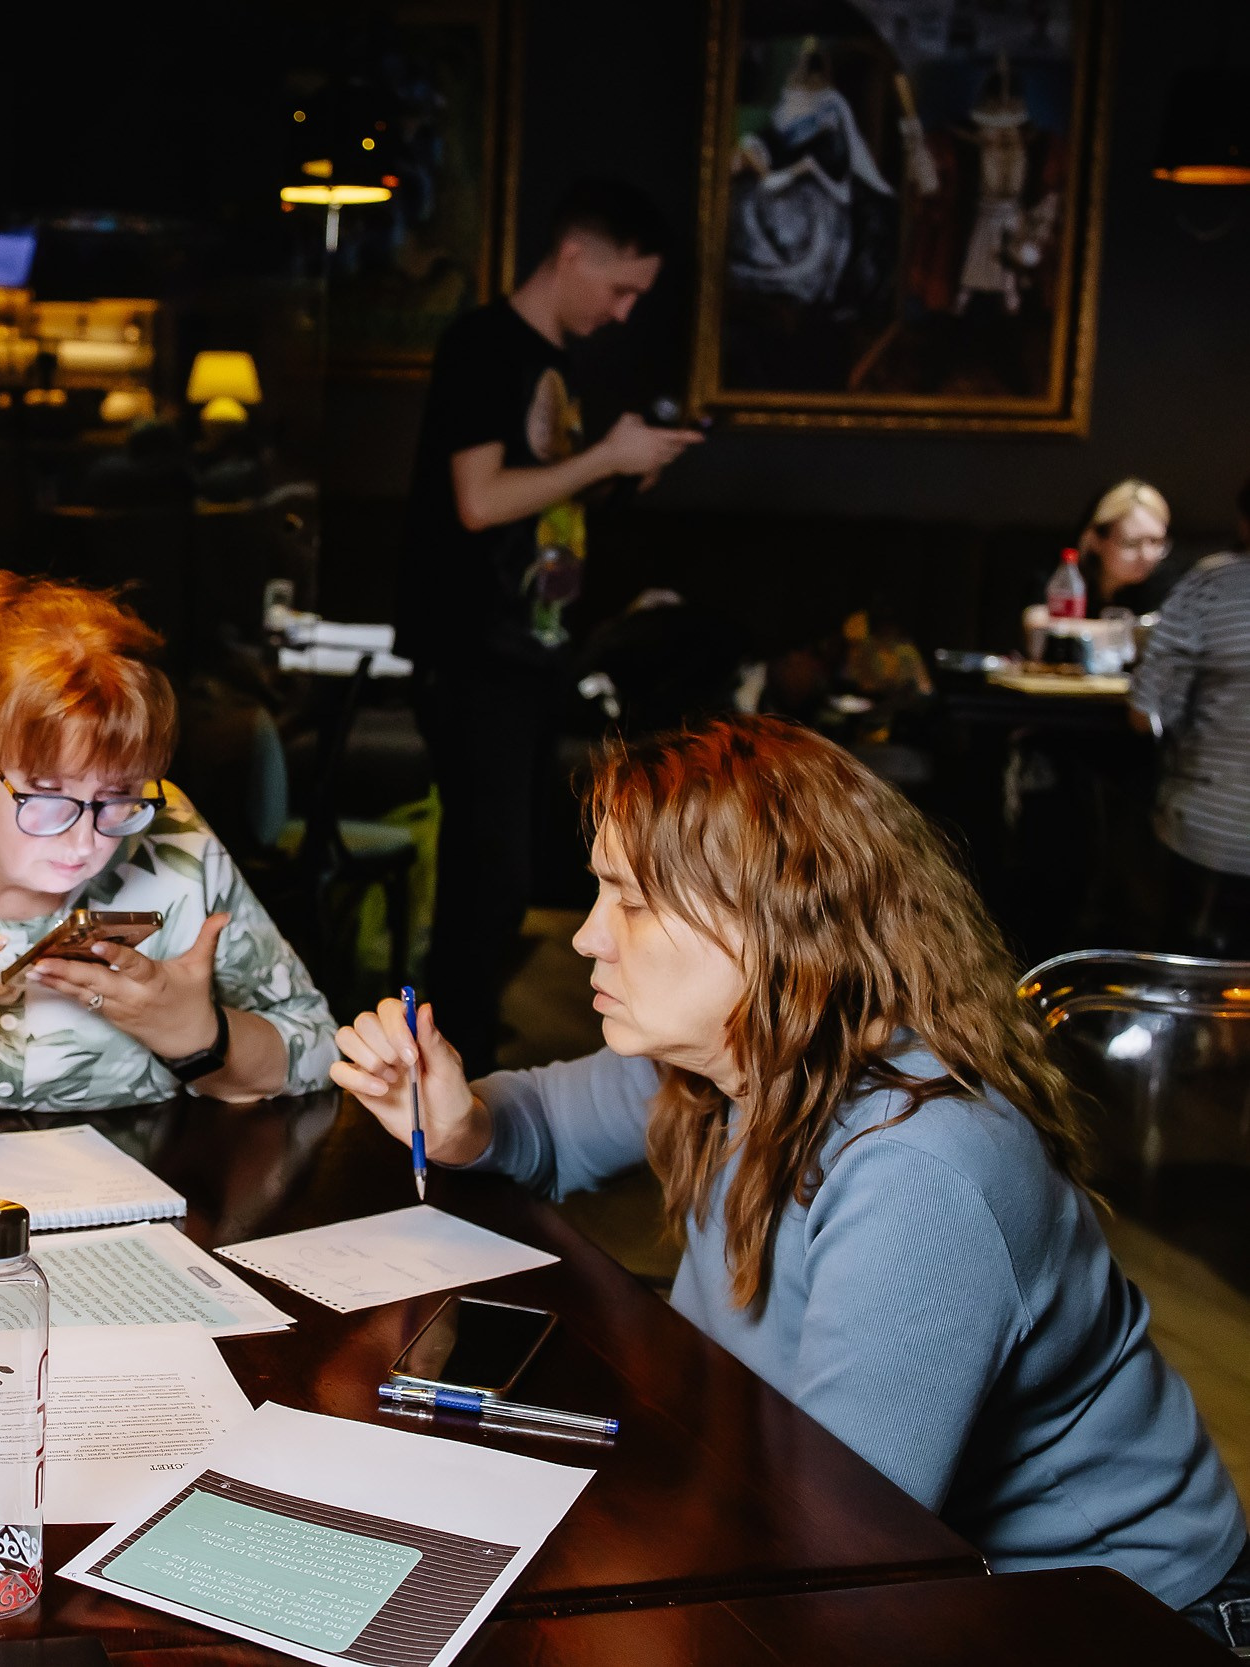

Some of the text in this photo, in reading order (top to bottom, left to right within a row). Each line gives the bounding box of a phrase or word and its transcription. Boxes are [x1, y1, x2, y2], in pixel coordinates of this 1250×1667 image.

[150, 1463, 189, 1471] CRET
[221, 1520, 274, 1537] старый
[196, 1536, 247, 1554] рулем,
[243, 1535, 303, 1554] линейке
[252, 1521, 407, 1563] музыкант будет нашей
[272, 1535, 298, 1545] Его
[331, 1533, 412, 1556] следующей
[246, 1544, 336, 1570] встретишься
[300, 1541, 390, 1567] художником.
[315, 1554, 376, 1572] вспомни
[263, 1558, 348, 1583] внимателен
[337, 1568, 377, 1581] когда
[146, 1546, 364, 1616] artist. His old musician will be our
[184, 1576, 256, 1601] encounter
[348, 1580, 383, 1594] Будь
[164, 1561, 357, 1624] remember the series with the
[306, 1587, 370, 1609] next goal.
[186, 1585, 344, 1640] Be careful while driving
[256, 1599, 282, 1609] you
[283, 1608, 321, 1623] when
[322, 1620, 351, 1632] and
